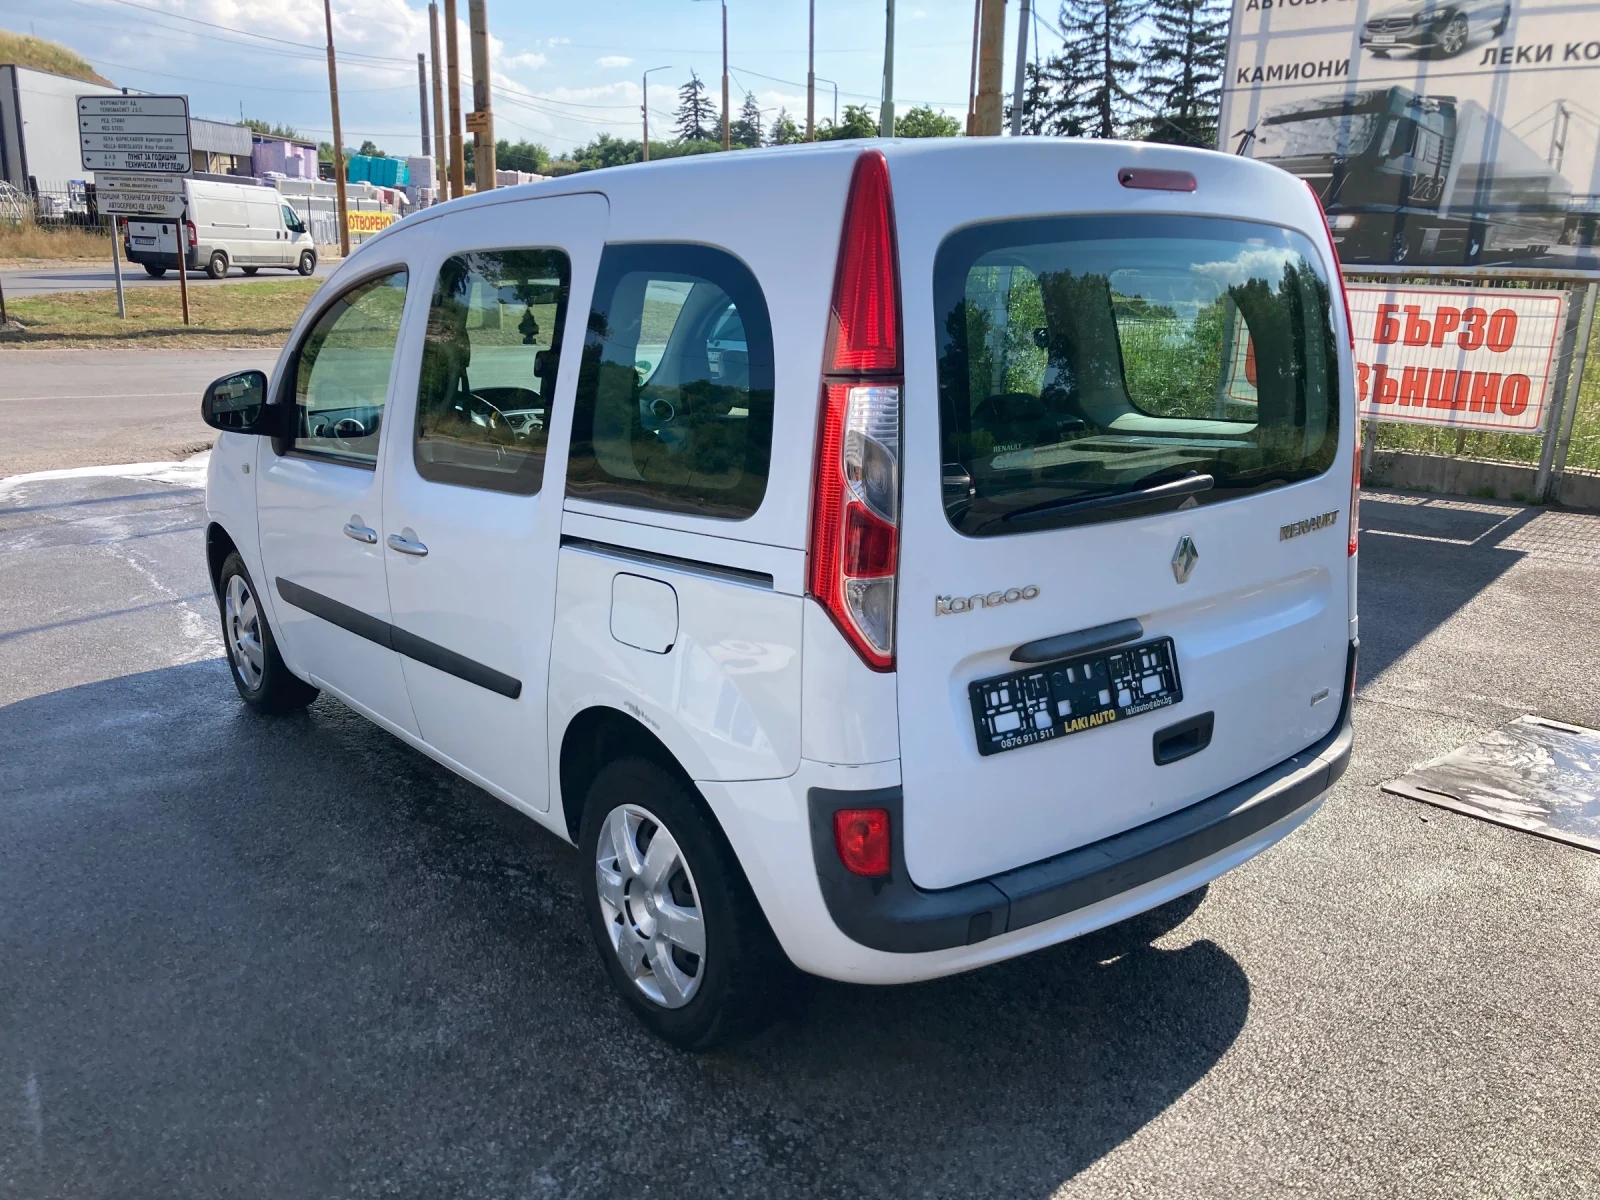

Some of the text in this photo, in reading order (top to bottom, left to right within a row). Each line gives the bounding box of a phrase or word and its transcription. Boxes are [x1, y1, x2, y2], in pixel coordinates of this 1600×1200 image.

[1479, 43, 1554, 66] ЛЕКИ
[1237, 59, 1350, 84] КАМИОНИ
[125, 161, 185, 171] ТЕХНИЧЕСКИ ПРЕГЛЕДИ
[127, 153, 177, 161] ПУНКТ ЗА ГОДИШНИ
[108, 202, 138, 210] АВТОСЕРВИЗ
[348, 214, 393, 231] ОТВОРЕНО
[1372, 303, 1519, 353] БЪРЗО
[993, 443, 1022, 453] RENAULT
[1279, 508, 1340, 542] RENAULT
[1000, 696, 1173, 749] 0876 911 511 LAKI AUTO lakiauto@abv.bg
